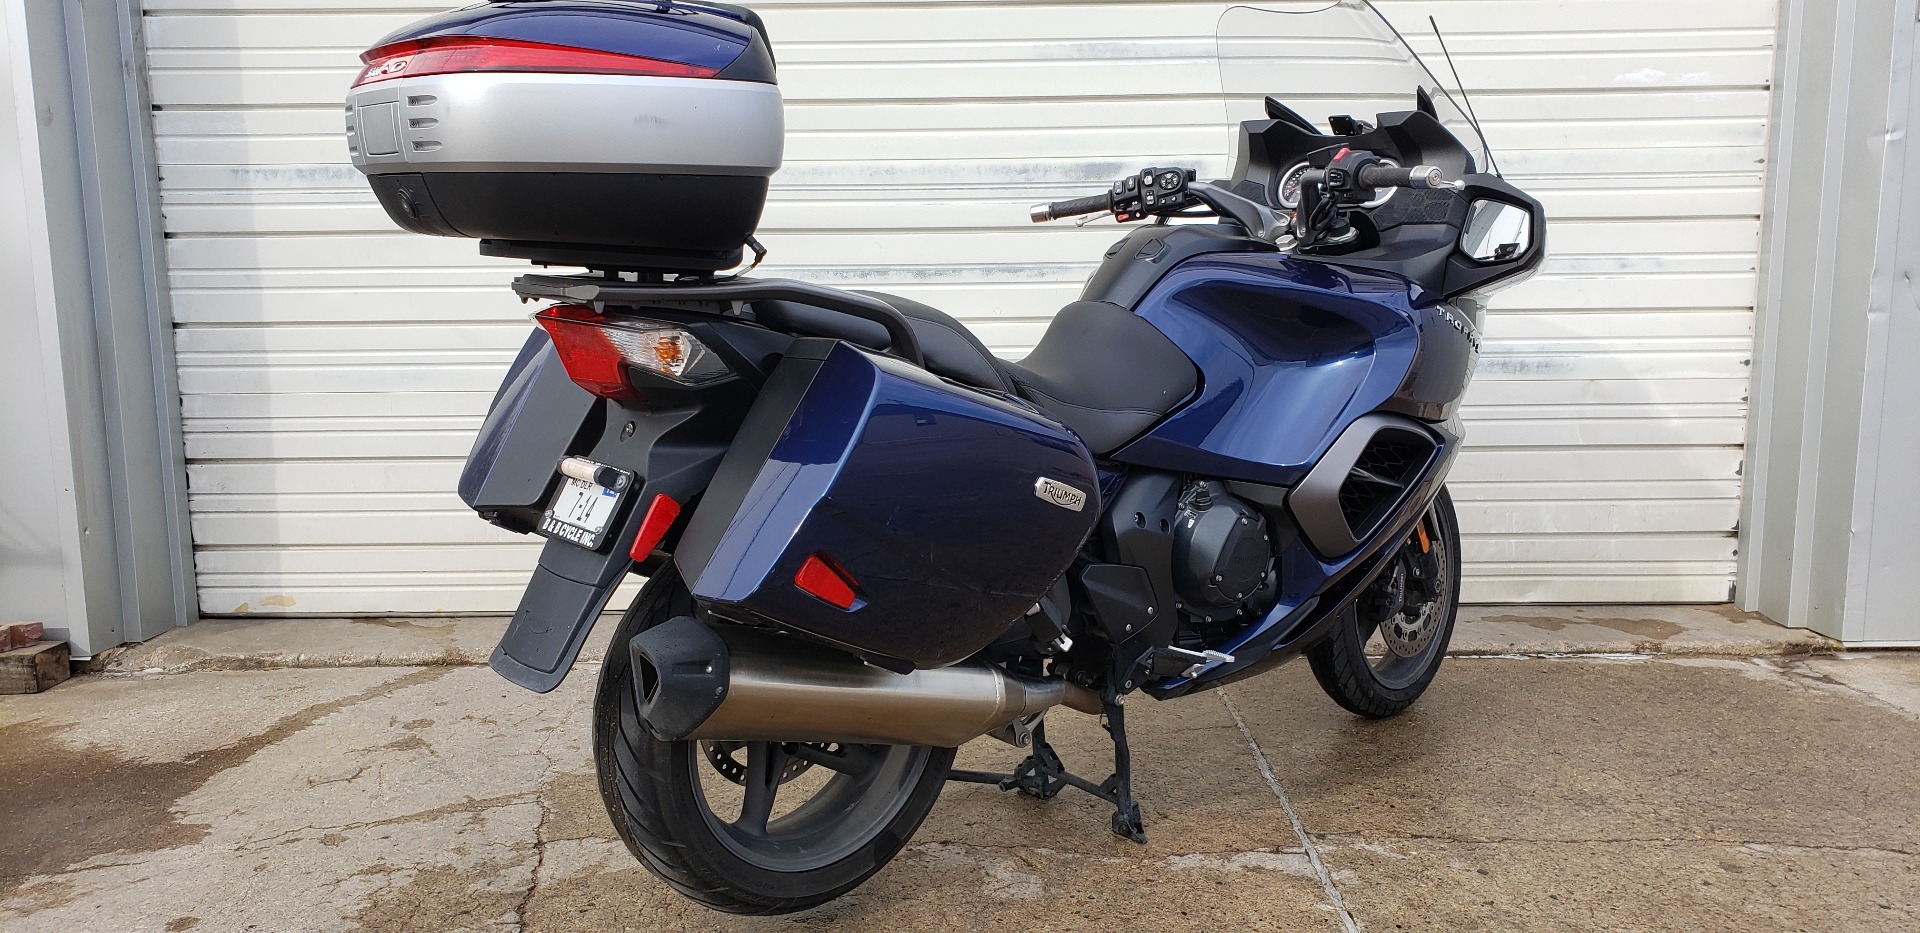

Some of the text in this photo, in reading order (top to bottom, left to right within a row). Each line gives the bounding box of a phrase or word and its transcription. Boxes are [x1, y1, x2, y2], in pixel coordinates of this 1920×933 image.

[1043, 481, 1083, 506] TRIUMPH
[542, 518, 551, 530] B
[547, 520, 556, 532] &
[553, 521, 562, 534] B
[559, 523, 584, 542] CYCLE
